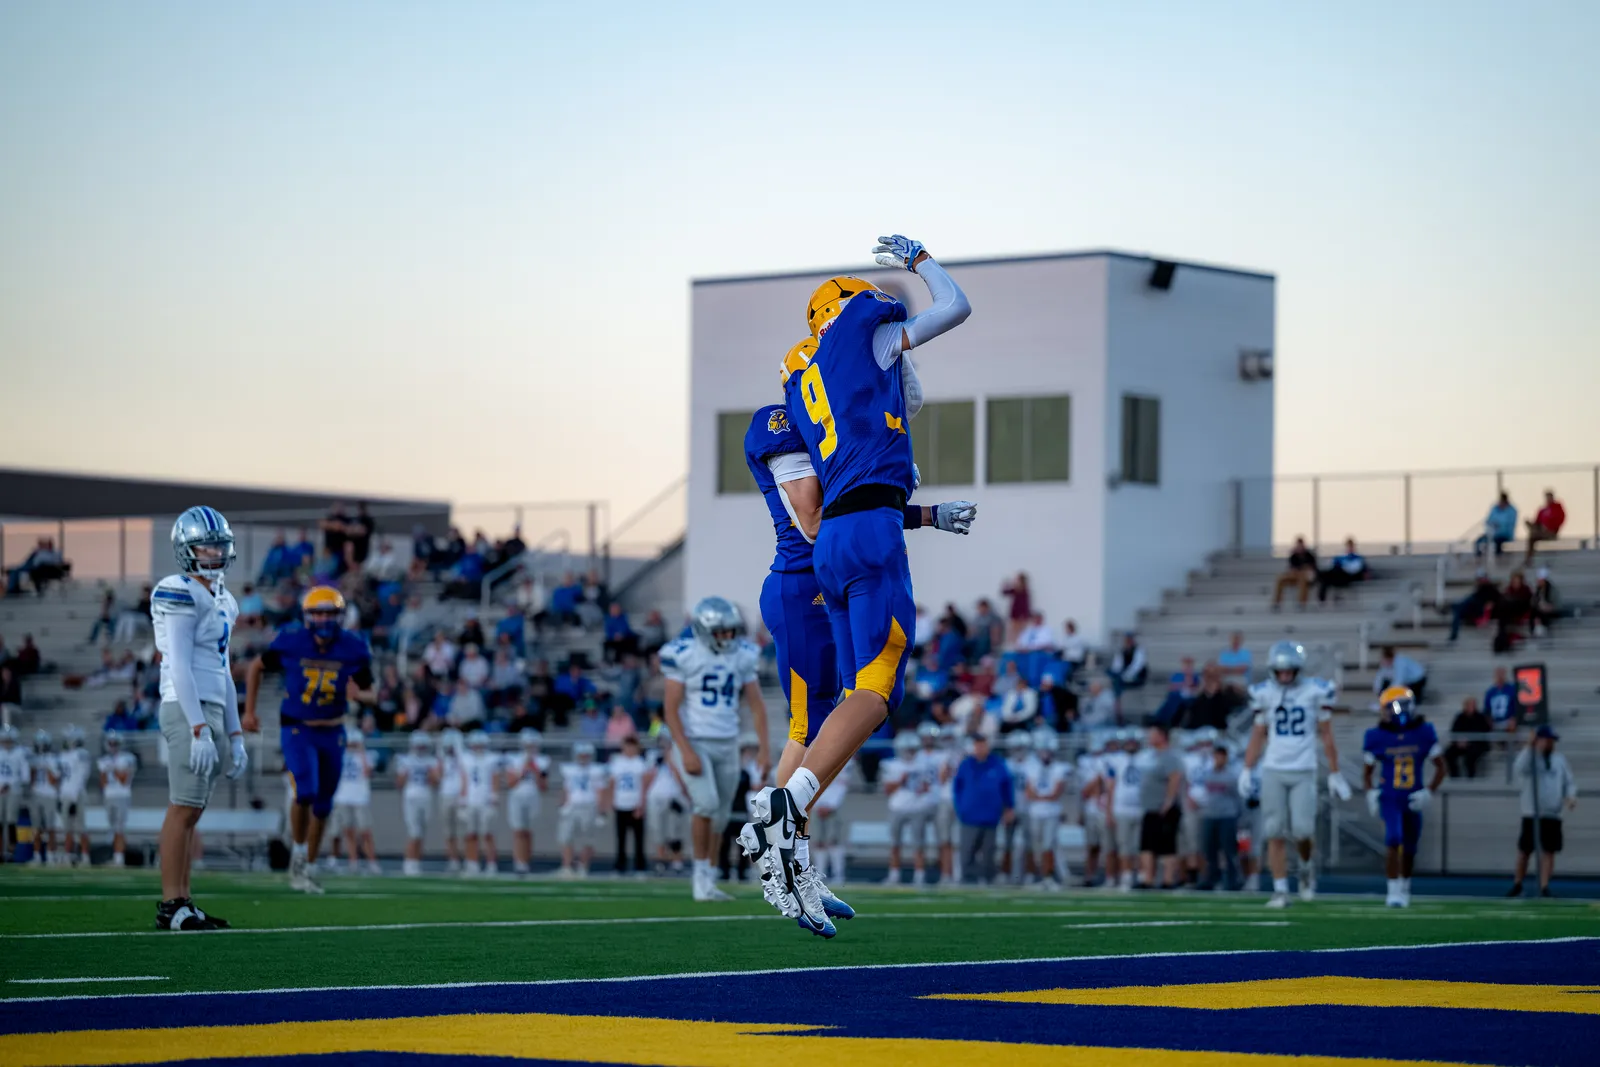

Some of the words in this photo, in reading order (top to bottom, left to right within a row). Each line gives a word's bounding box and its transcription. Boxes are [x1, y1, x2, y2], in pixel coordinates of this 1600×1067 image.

[801, 362, 837, 462] 9
[301, 668, 338, 705] 75
[702, 674, 734, 707] 54
[1275, 706, 1305, 736] 22
